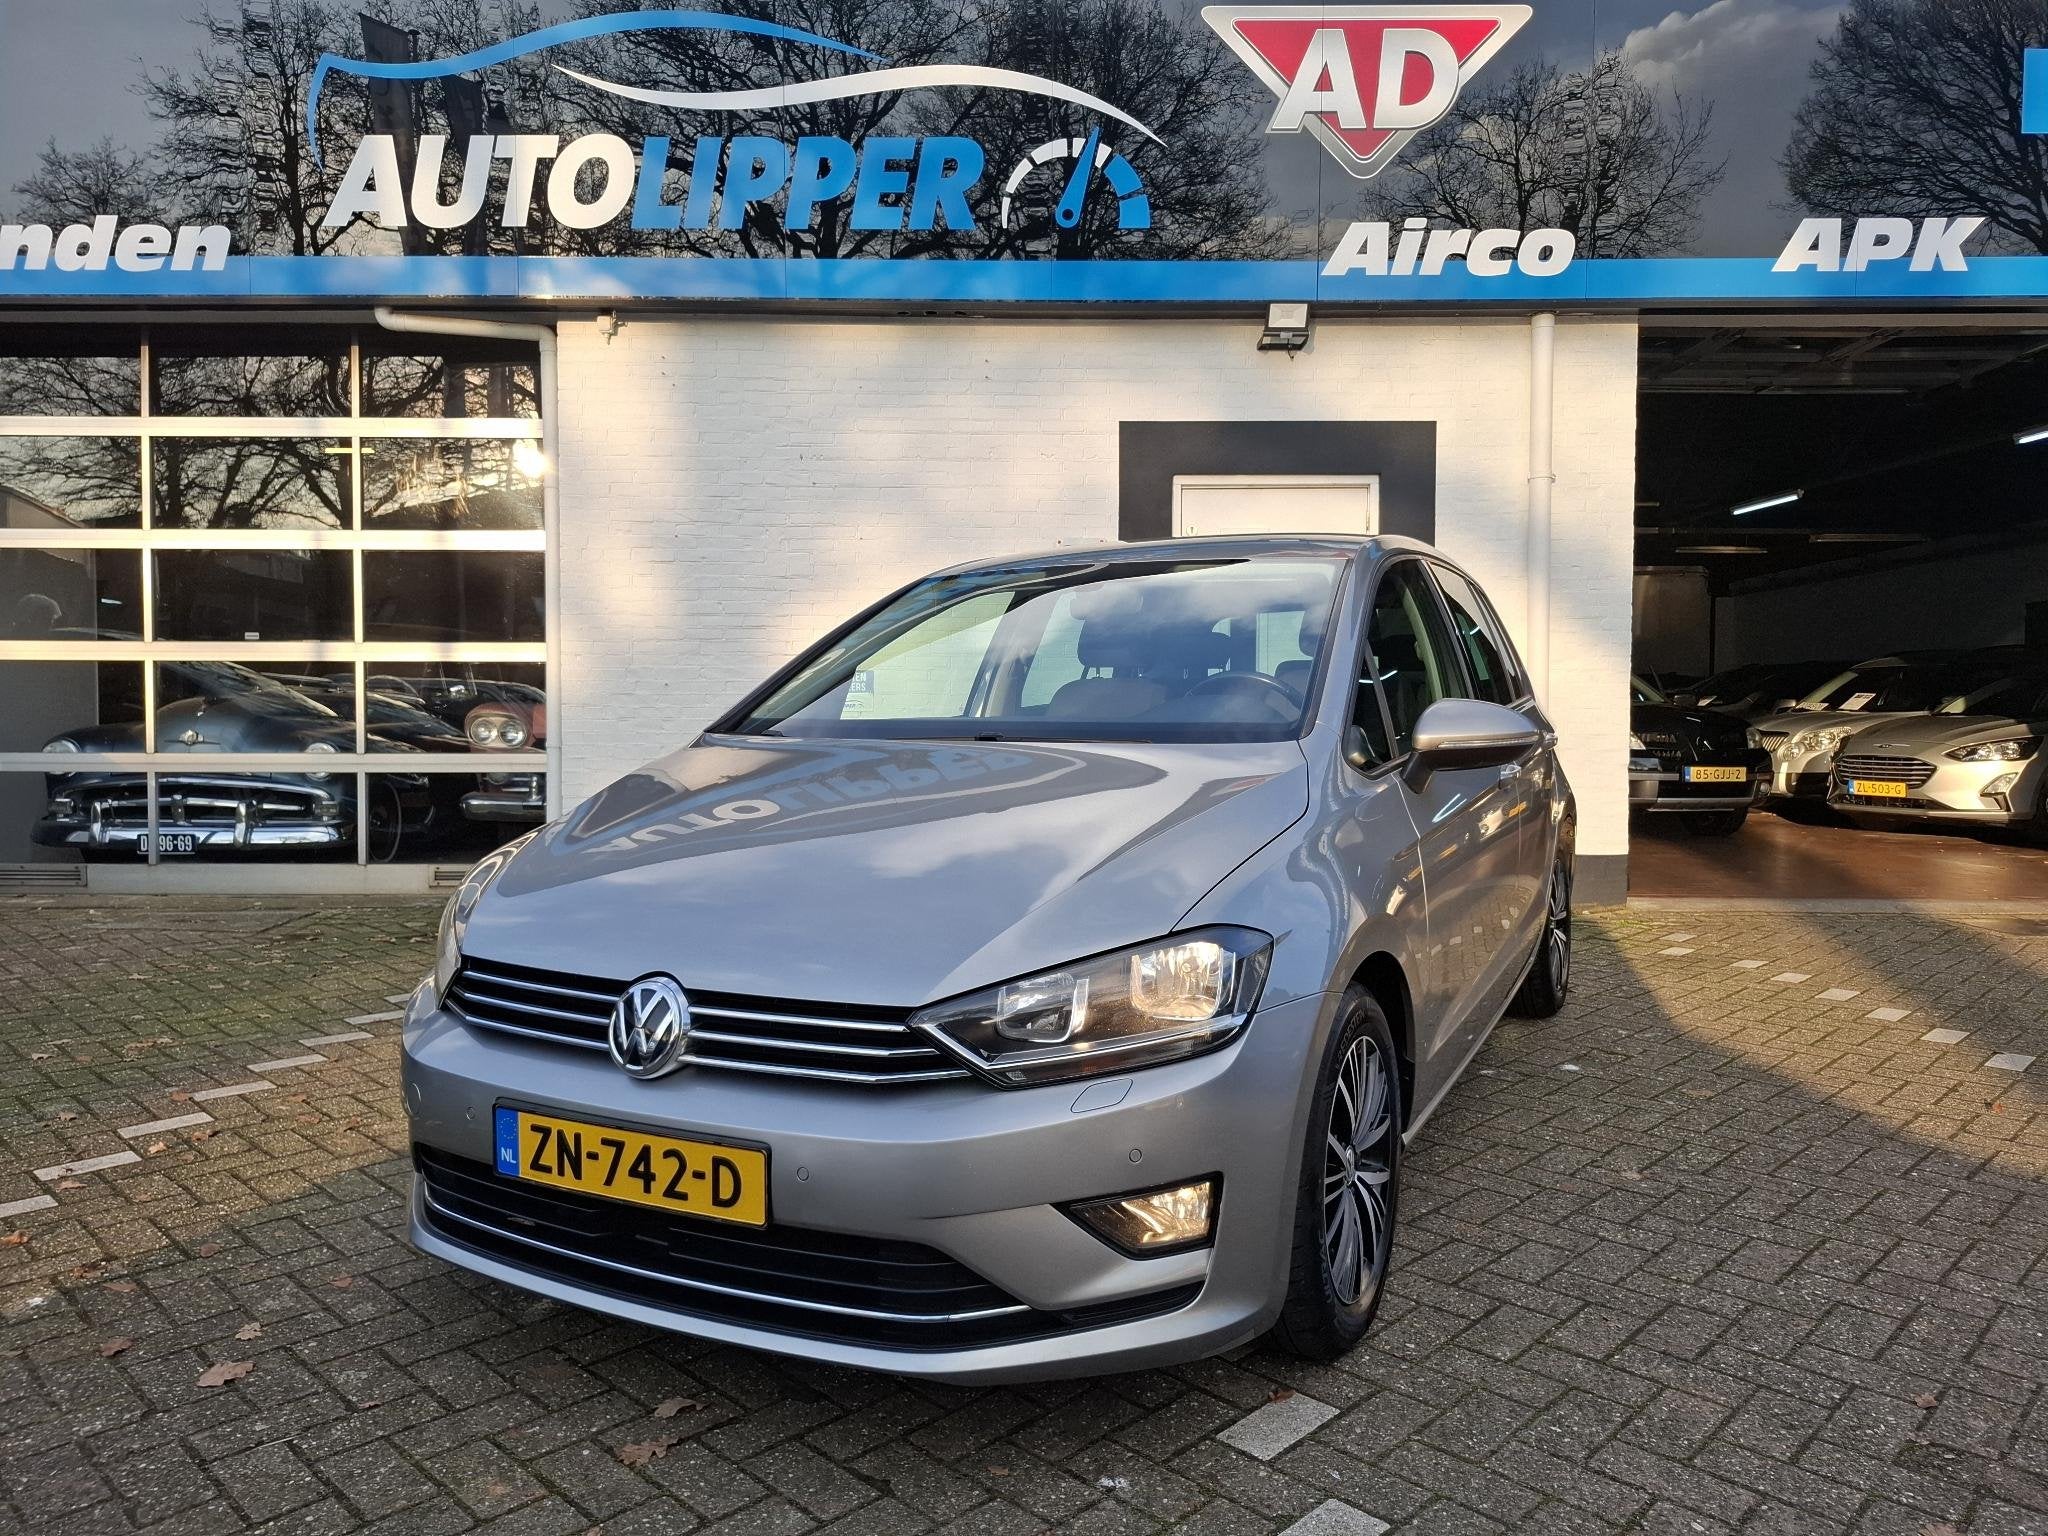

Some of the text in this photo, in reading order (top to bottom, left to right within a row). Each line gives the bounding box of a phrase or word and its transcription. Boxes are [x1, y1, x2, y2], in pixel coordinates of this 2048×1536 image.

[1268, 28, 1460, 132] AD
[0, 214, 231, 272] nden
[1321, 218, 1576, 277] Airco
[1771, 217, 1986, 272] APK
[1695, 769, 1741, 780] 85-GJJ-2
[1857, 782, 1902, 795] ZL-503-G
[500, 1123, 743, 1208] NL ZN-742-D
